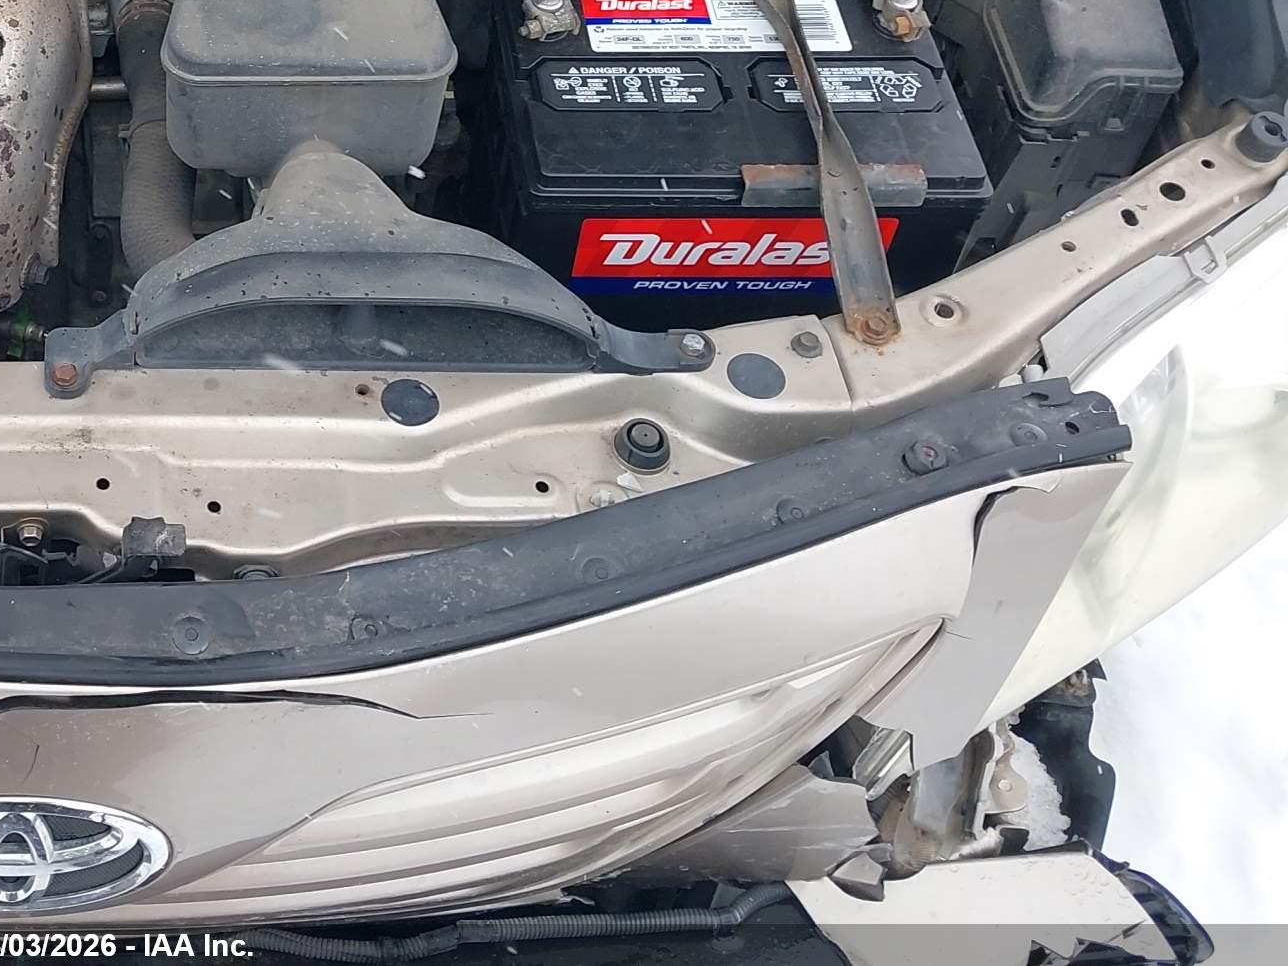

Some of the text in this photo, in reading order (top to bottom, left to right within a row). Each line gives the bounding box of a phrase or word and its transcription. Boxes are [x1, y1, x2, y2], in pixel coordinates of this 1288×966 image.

[580, 66, 630, 74] DANGER
[638, 66, 681, 74] POISON
[599, 233, 831, 266] Duralas
[633, 280, 813, 290] PROVEN TOUGH
